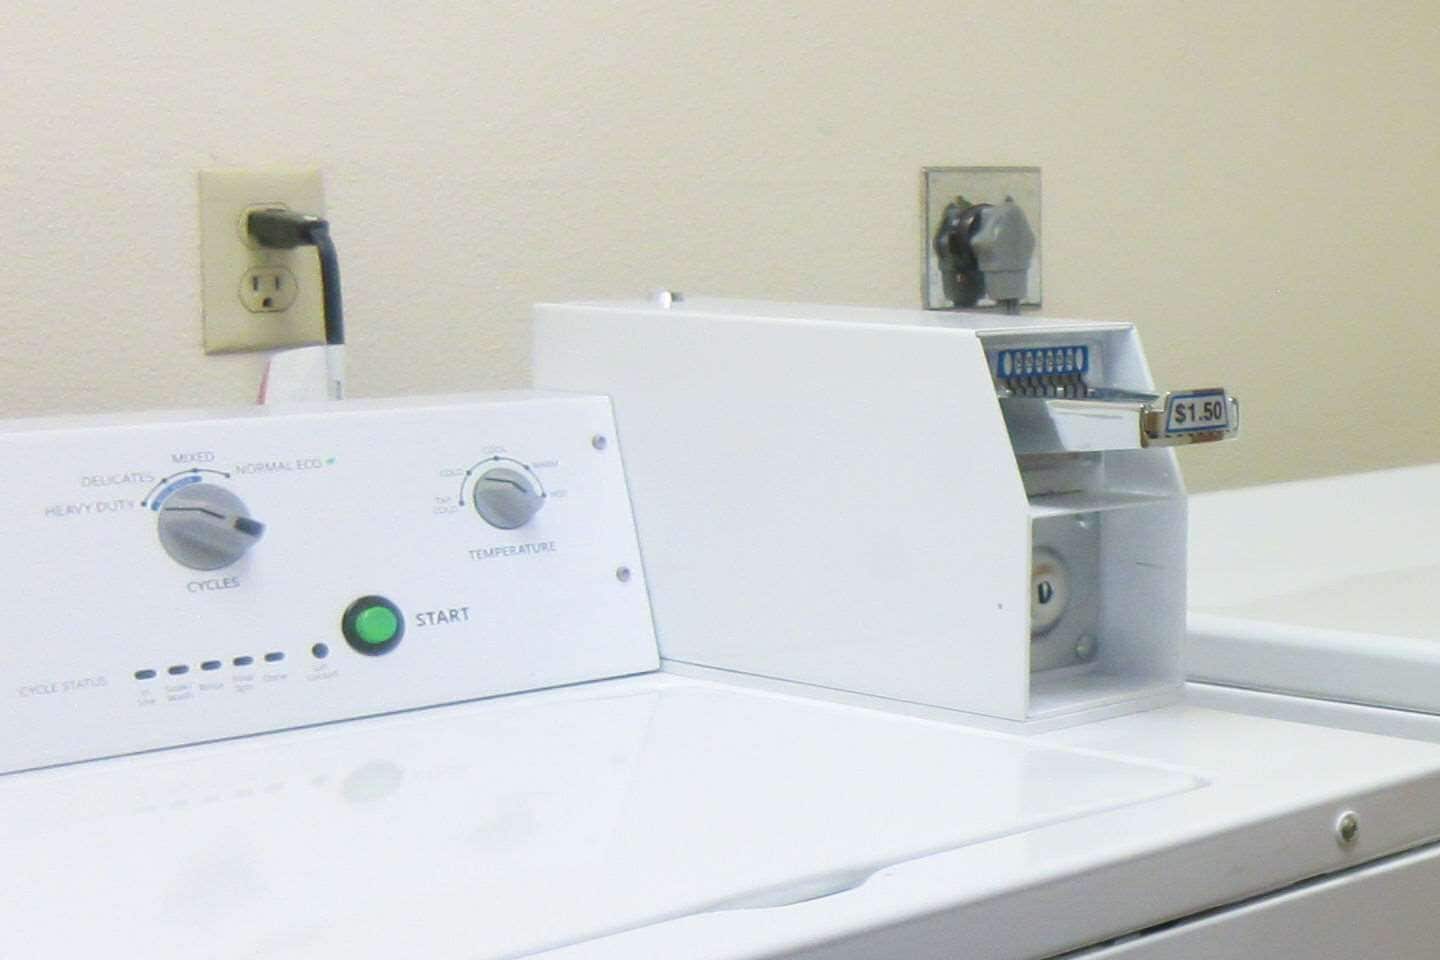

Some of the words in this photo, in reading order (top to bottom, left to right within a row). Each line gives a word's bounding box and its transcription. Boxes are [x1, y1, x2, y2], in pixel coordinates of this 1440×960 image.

[1174, 400, 1223, 424] $1.50
[171, 451, 216, 464] MIXED
[235, 461, 292, 475] NORMAL
[81, 472, 155, 487] DELICATES
[45, 504, 91, 517] HEAVY
[96, 499, 135, 513] DUTY
[468, 540, 557, 561] TEMPERATURE
[186, 576, 240, 593] CYCLES
[415, 607, 470, 627] START
[18, 683, 57, 697] CYCLE
[60, 676, 109, 693] STATUS
